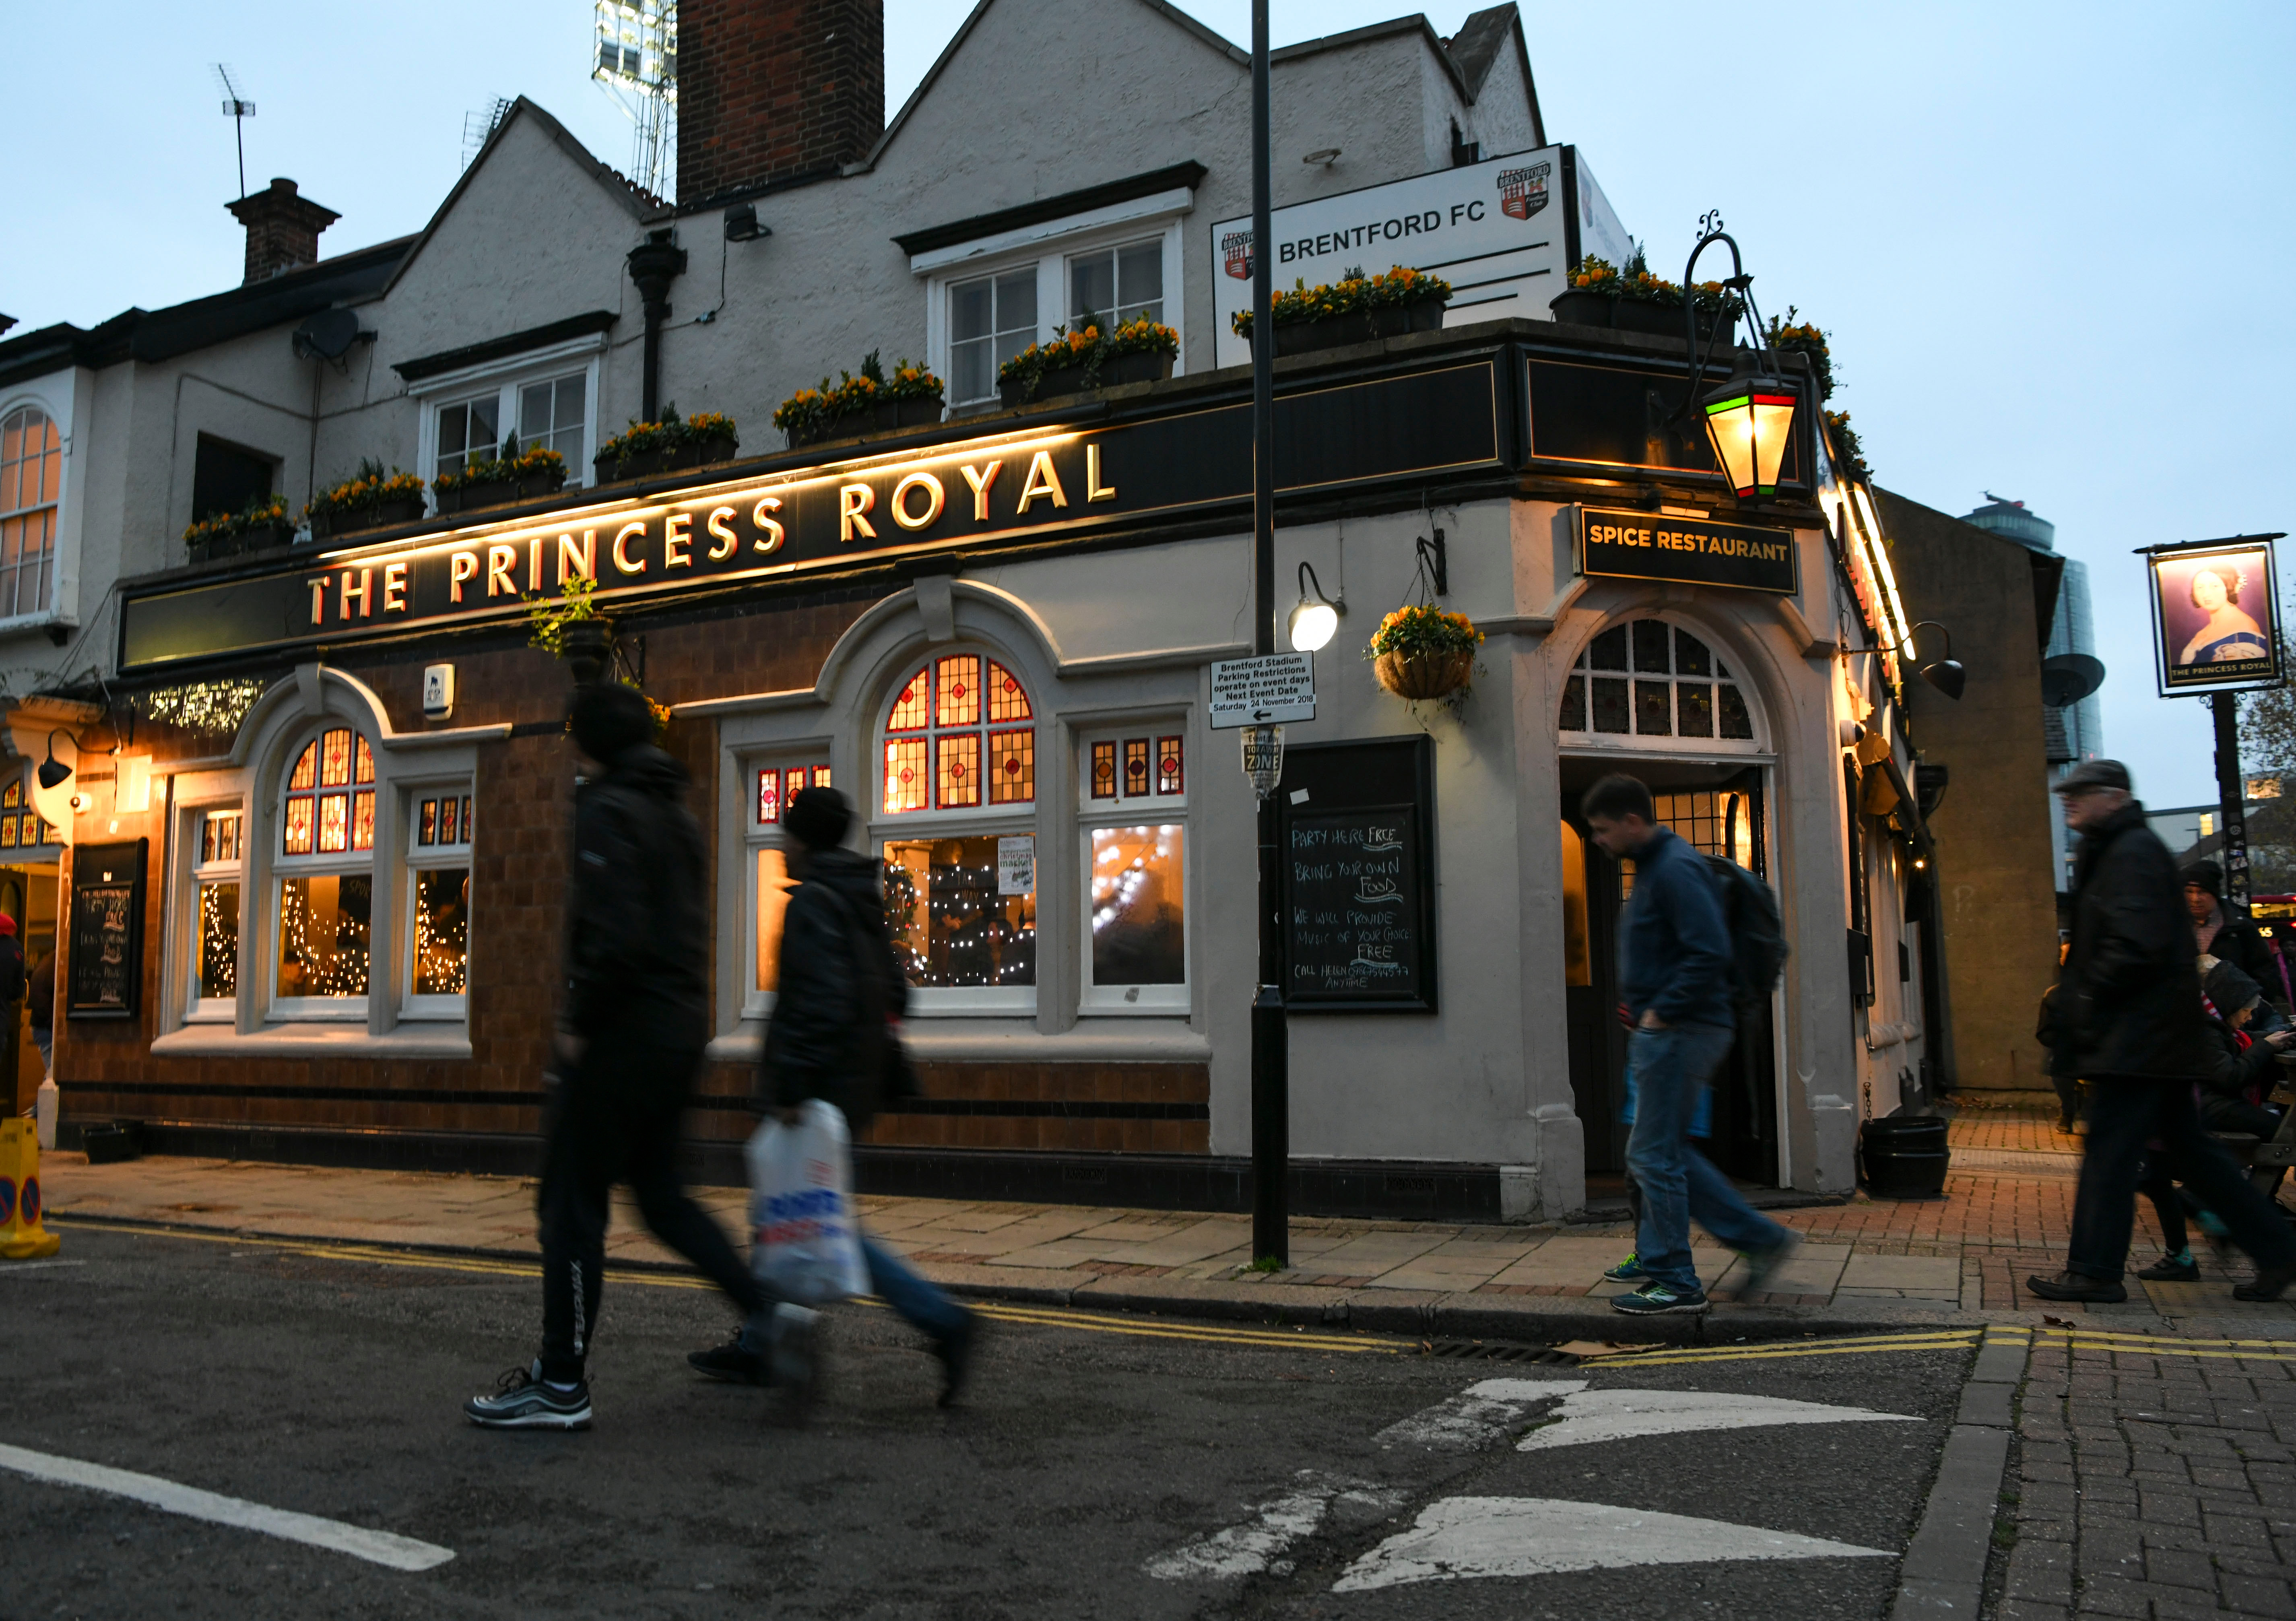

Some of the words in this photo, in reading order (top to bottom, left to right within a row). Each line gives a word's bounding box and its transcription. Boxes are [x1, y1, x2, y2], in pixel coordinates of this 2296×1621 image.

[1499, 165, 1549, 187] BRENTFORD
[1280, 210, 1441, 264] BRENTFORD
[1450, 200, 1485, 227] FC
[307, 563, 407, 625] THE
[451, 497, 785, 603] PRINCESS
[841, 443, 1116, 542] ROYAL
[1590, 525, 1651, 547] SPICE
[1657, 531, 1788, 562] RESTAURANT
[1221, 660, 1262, 672] Brentford
[1265, 656, 1302, 667] Stadium
[2172, 668, 2189, 676] THE
[2193, 664, 2237, 674] PRINCESS
[2240, 662, 2271, 671] ROYAL
[1218, 672, 1250, 682] Parking
[1254, 665, 1306, 678] Restrictions
[1214, 682, 1247, 693] operate
[1263, 678, 1287, 687] event
[1290, 675, 1310, 685] days
[1226, 691, 1247, 701] Next
[1250, 688, 1275, 699] Event
[1278, 686, 1298, 695] Date
[1213, 701, 1247, 712] Saturday
[1250, 699, 1260, 708] 24
[1262, 697, 1295, 707] November
[1298, 695, 1314, 703] 2018
[1247, 754, 1279, 770] ZONE
[1292, 829, 1327, 849] PARTY
[1332, 828, 1364, 845] HERE
[1368, 827, 1397, 843] FREE
[1295, 861, 1332, 882] BRING
[1337, 860, 1362, 876] YOUR
[1366, 856, 1399, 874] OWN
[1294, 906, 1310, 924] WE
[1315, 912, 1339, 925] WILL
[1347, 909, 1397, 925] PROVIDE
[1297, 930, 1330, 946] MUSIC
[1337, 930, 1350, 943] OF
[1357, 929, 1381, 942] YOUR
[1357, 943, 1394, 959] FREE
[1294, 964, 1315, 978] CALL
[1321, 963, 1347, 978] HELEN
[1325, 976, 1368, 989] ANYTIME
